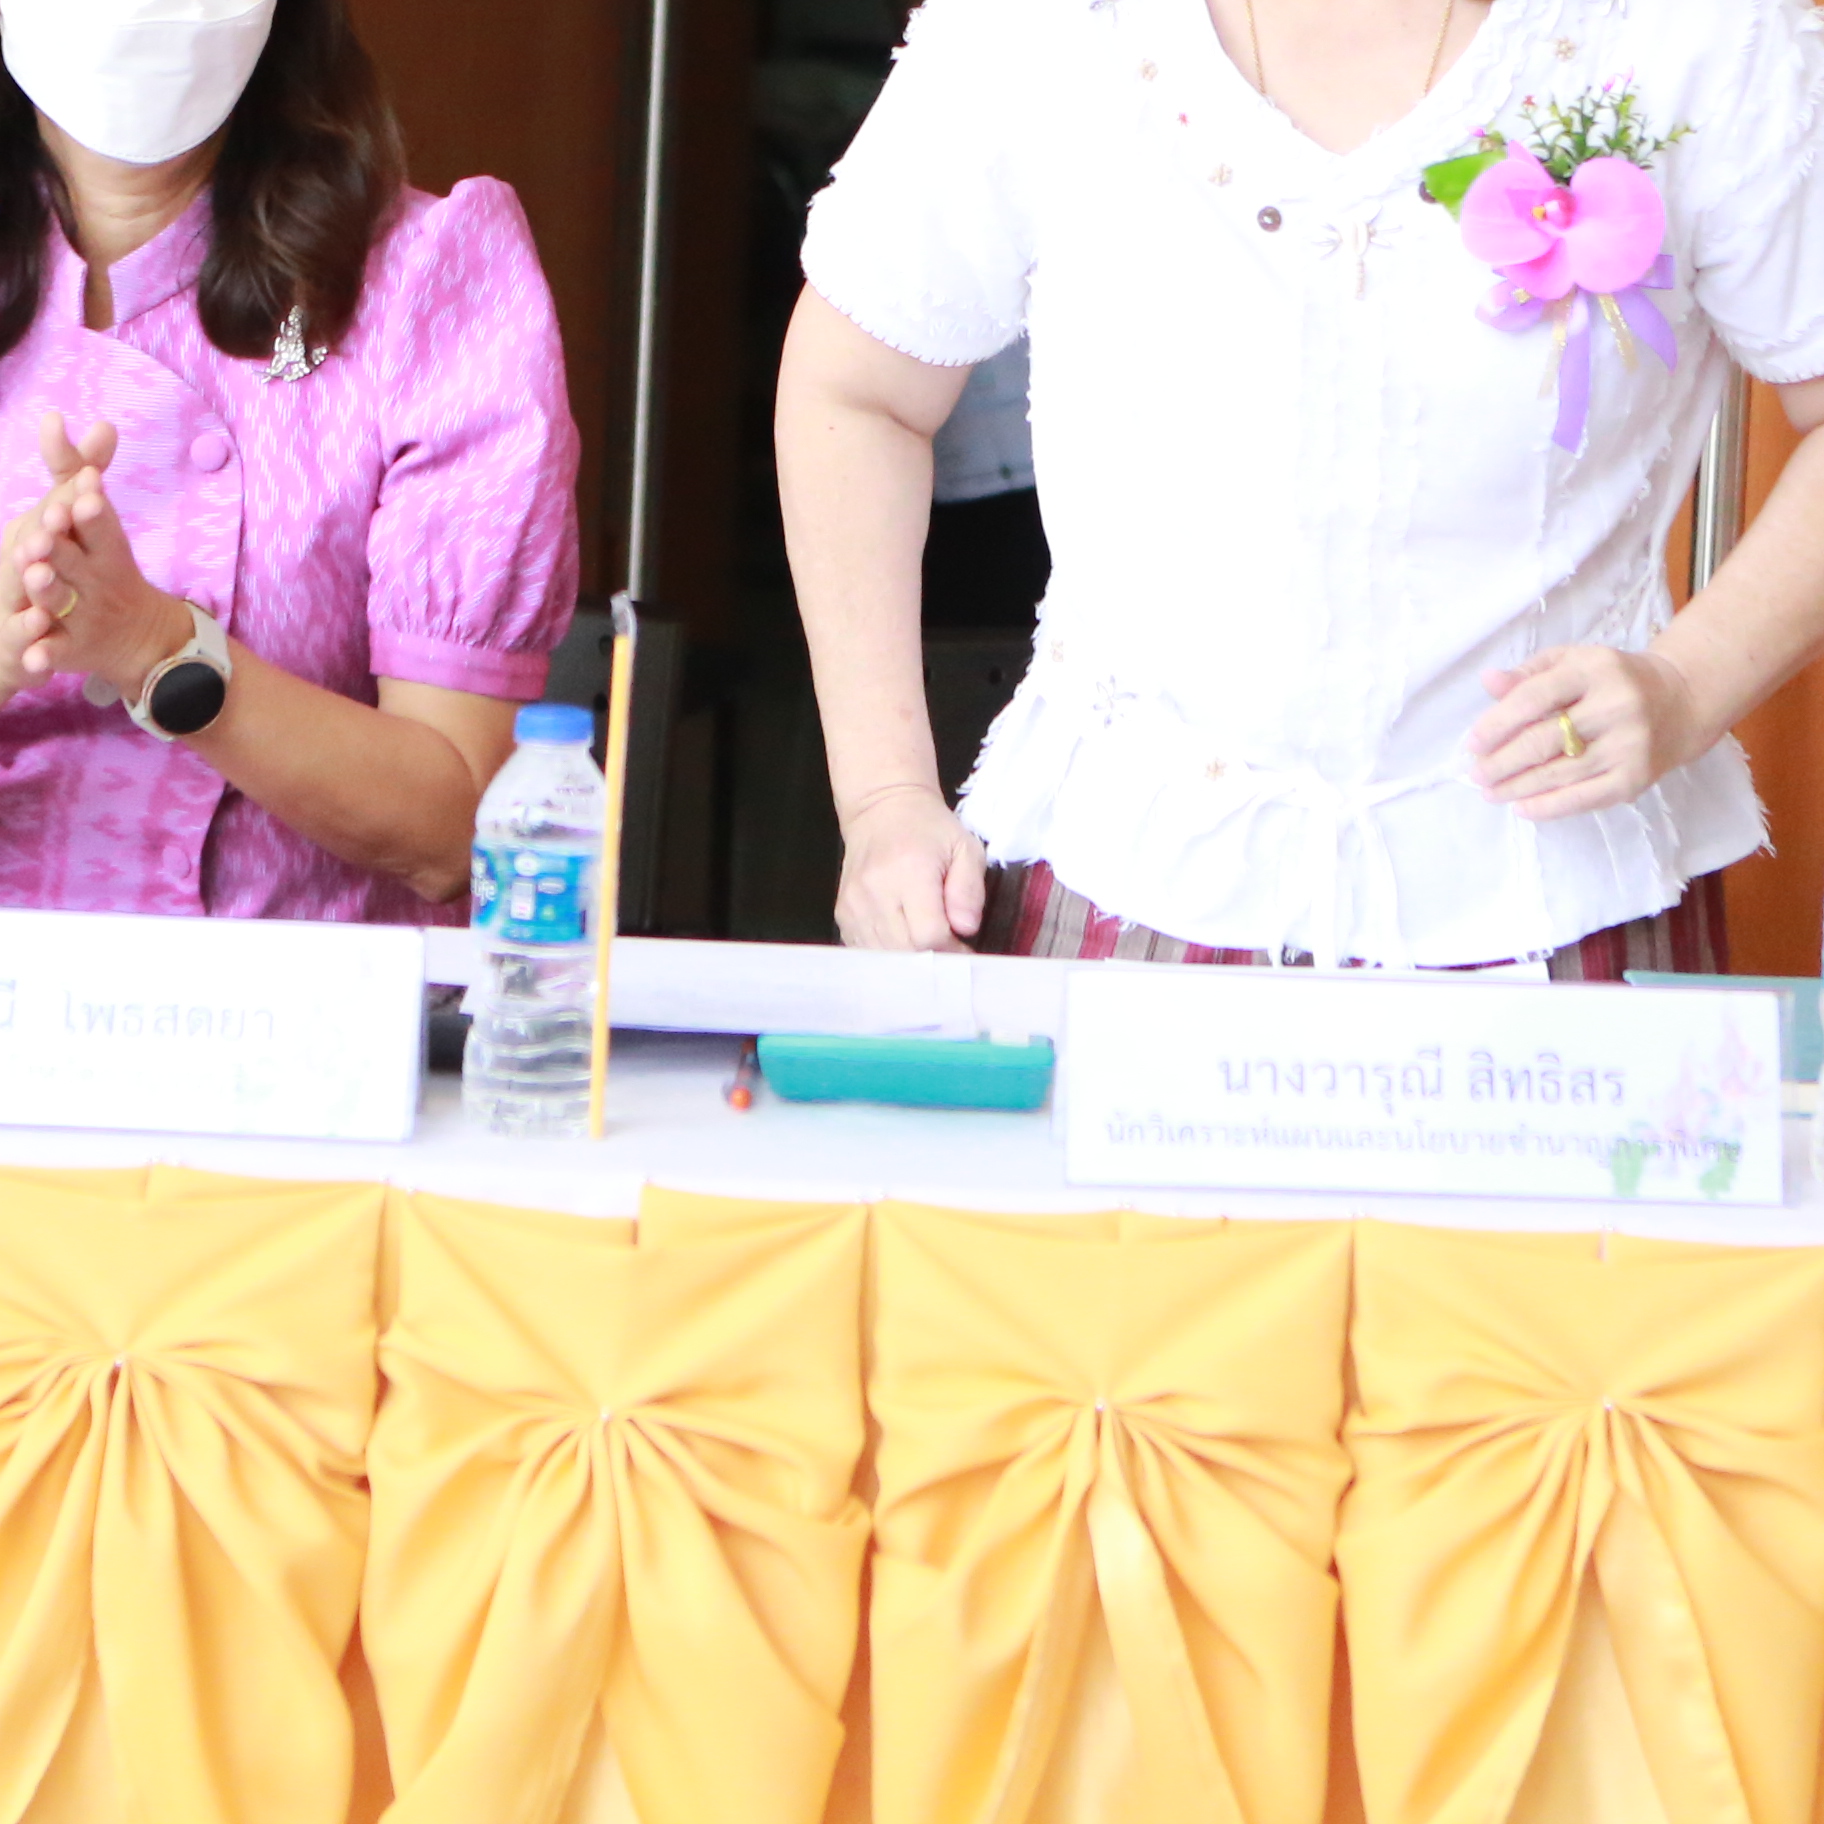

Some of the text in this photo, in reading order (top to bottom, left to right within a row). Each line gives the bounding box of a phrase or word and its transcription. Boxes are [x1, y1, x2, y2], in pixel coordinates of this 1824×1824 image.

[1217, 1044, 1628, 1116] นางวารุณี สิทธิสร
